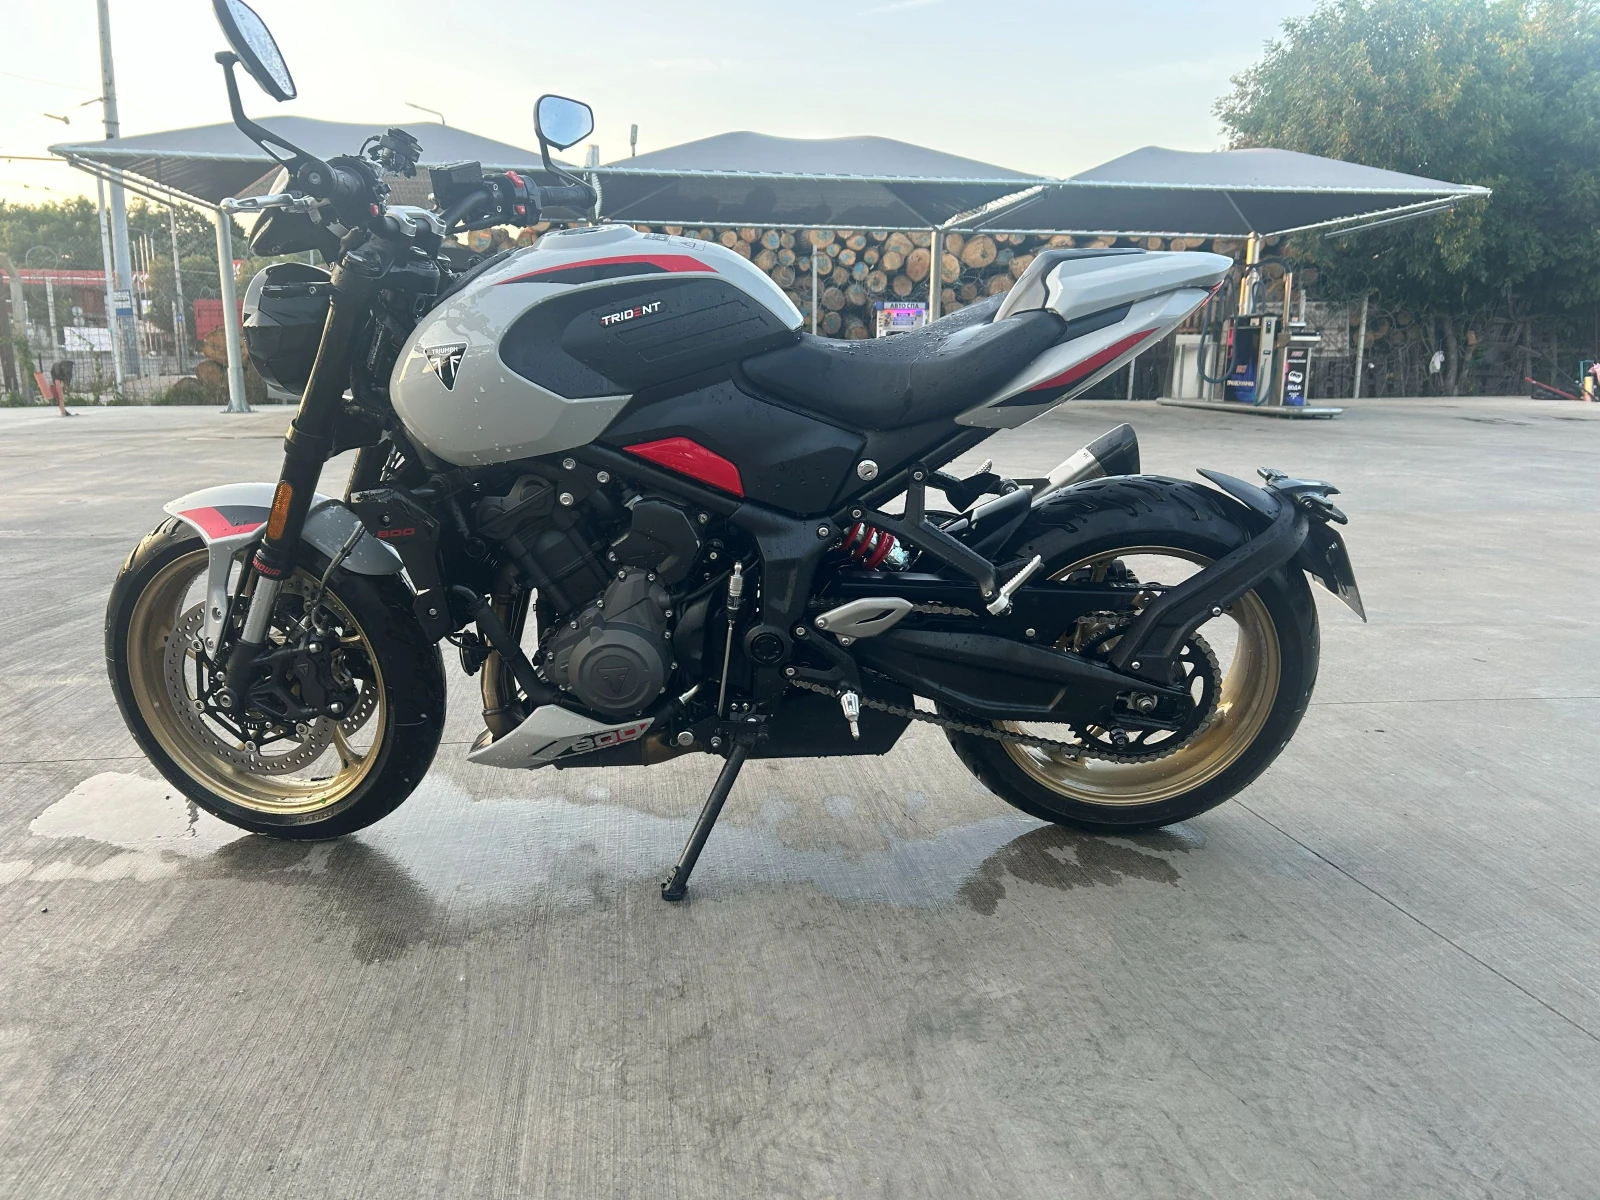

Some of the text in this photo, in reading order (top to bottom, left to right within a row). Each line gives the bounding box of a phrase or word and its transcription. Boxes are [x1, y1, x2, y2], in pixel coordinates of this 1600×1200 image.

[601, 301, 661, 326] TRIDENT
[431, 346, 459, 355] TRIUMPH
[377, 527, 415, 538] 800
[571, 725, 642, 752] 800
